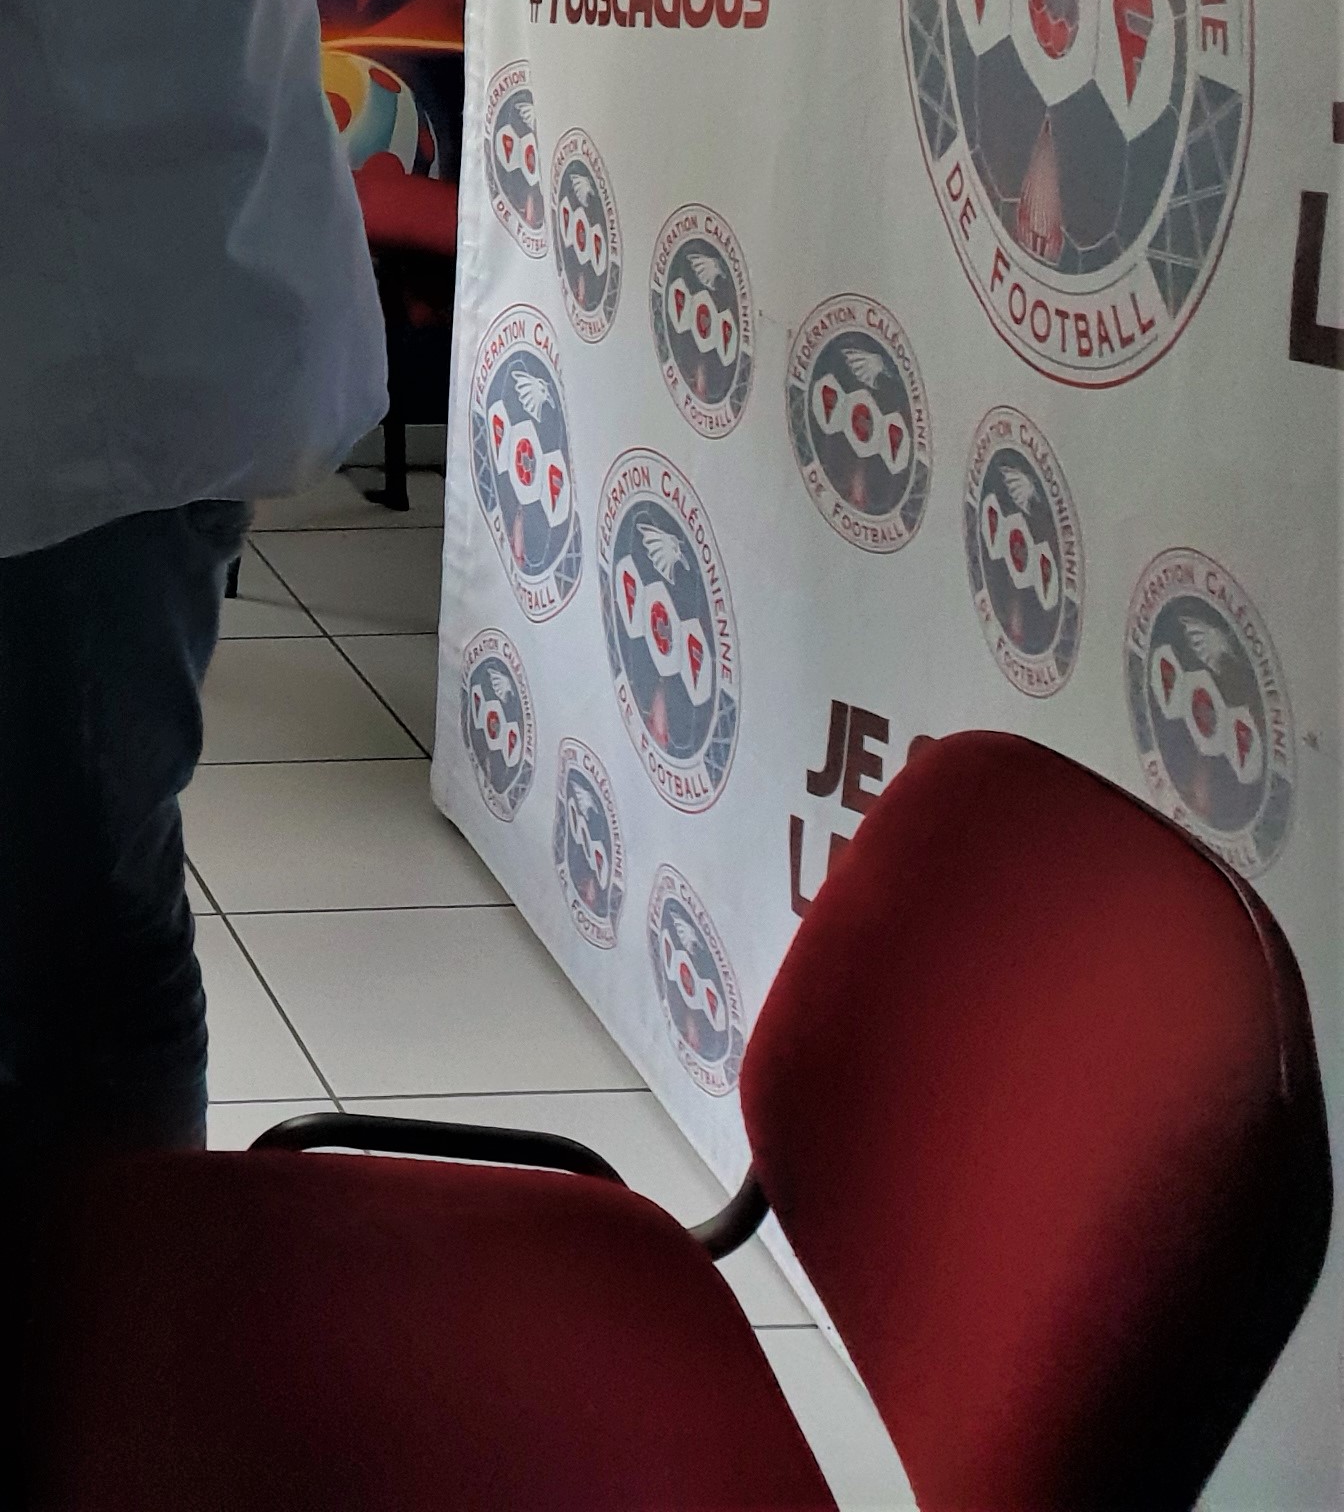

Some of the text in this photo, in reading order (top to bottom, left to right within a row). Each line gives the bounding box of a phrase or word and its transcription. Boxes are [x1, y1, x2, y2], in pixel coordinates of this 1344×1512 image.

[946, 162, 1157, 357] DE FOOTBALL
[661, 471, 733, 684] CALÉDONIENNE
[832, 503, 904, 543] FOOTBALL
[641, 733, 709, 798] FOOTBALL
